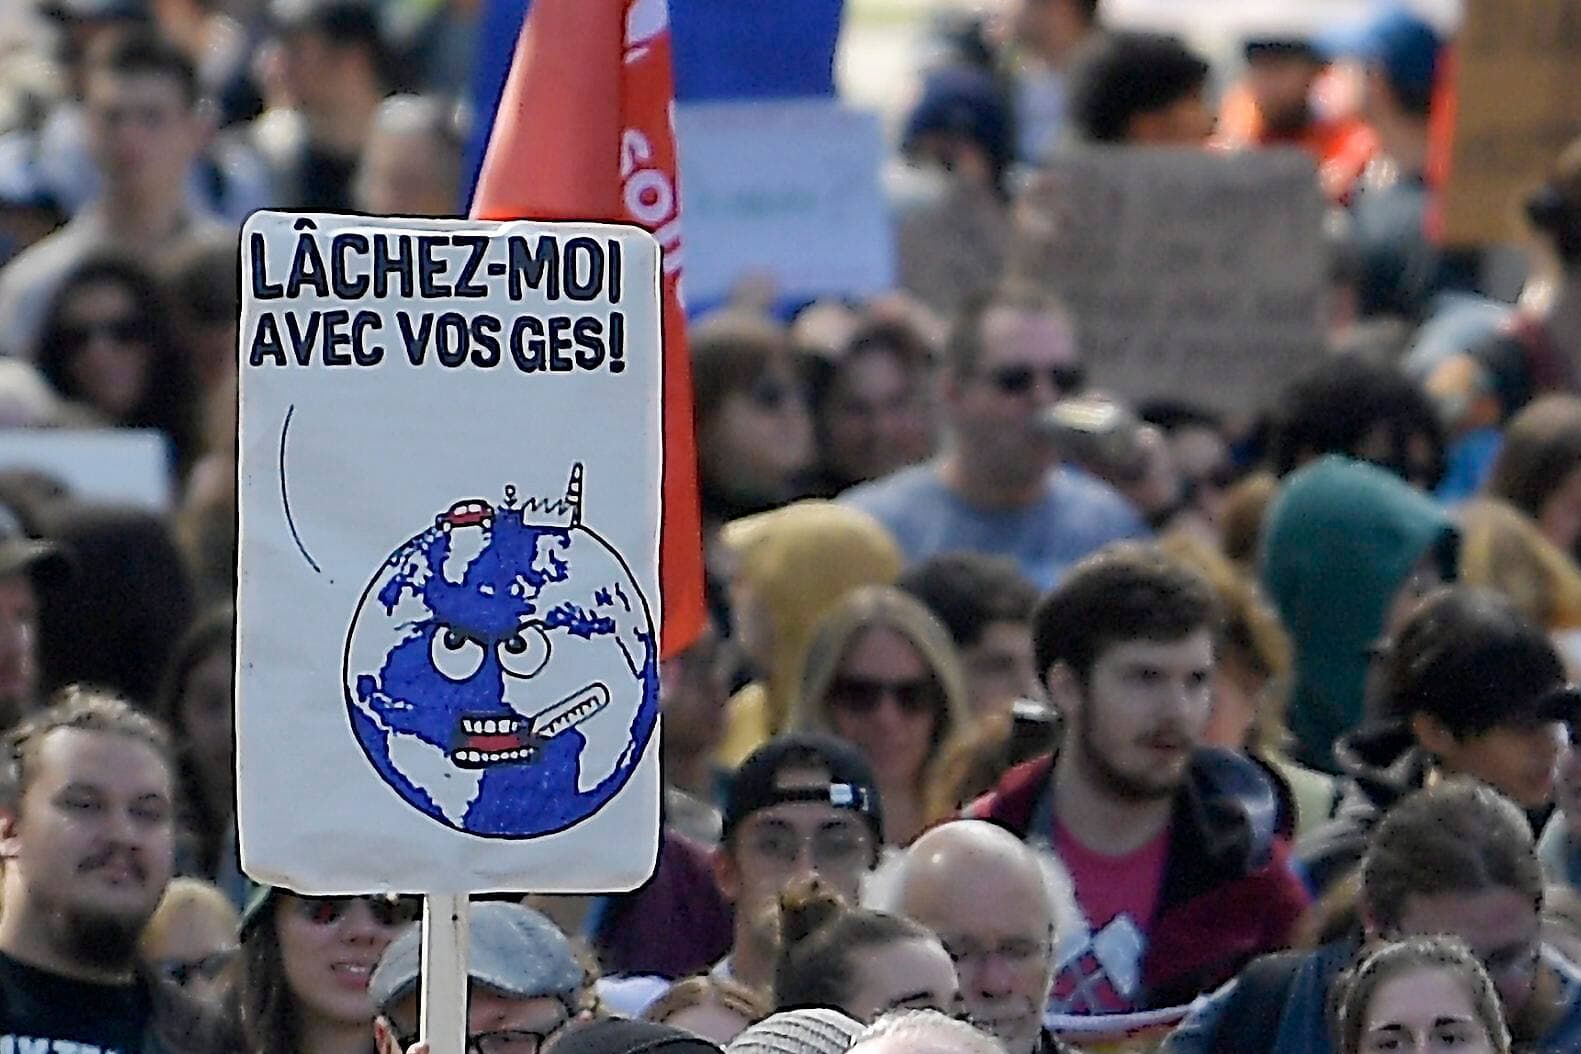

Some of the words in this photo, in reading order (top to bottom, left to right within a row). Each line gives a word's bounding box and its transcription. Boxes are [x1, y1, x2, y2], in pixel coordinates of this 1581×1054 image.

[250, 218, 621, 304] LÂCHEZ-MOI
[249, 310, 384, 367] AVEC
[397, 311, 501, 368] VOS
[510, 311, 626, 373] GES!
